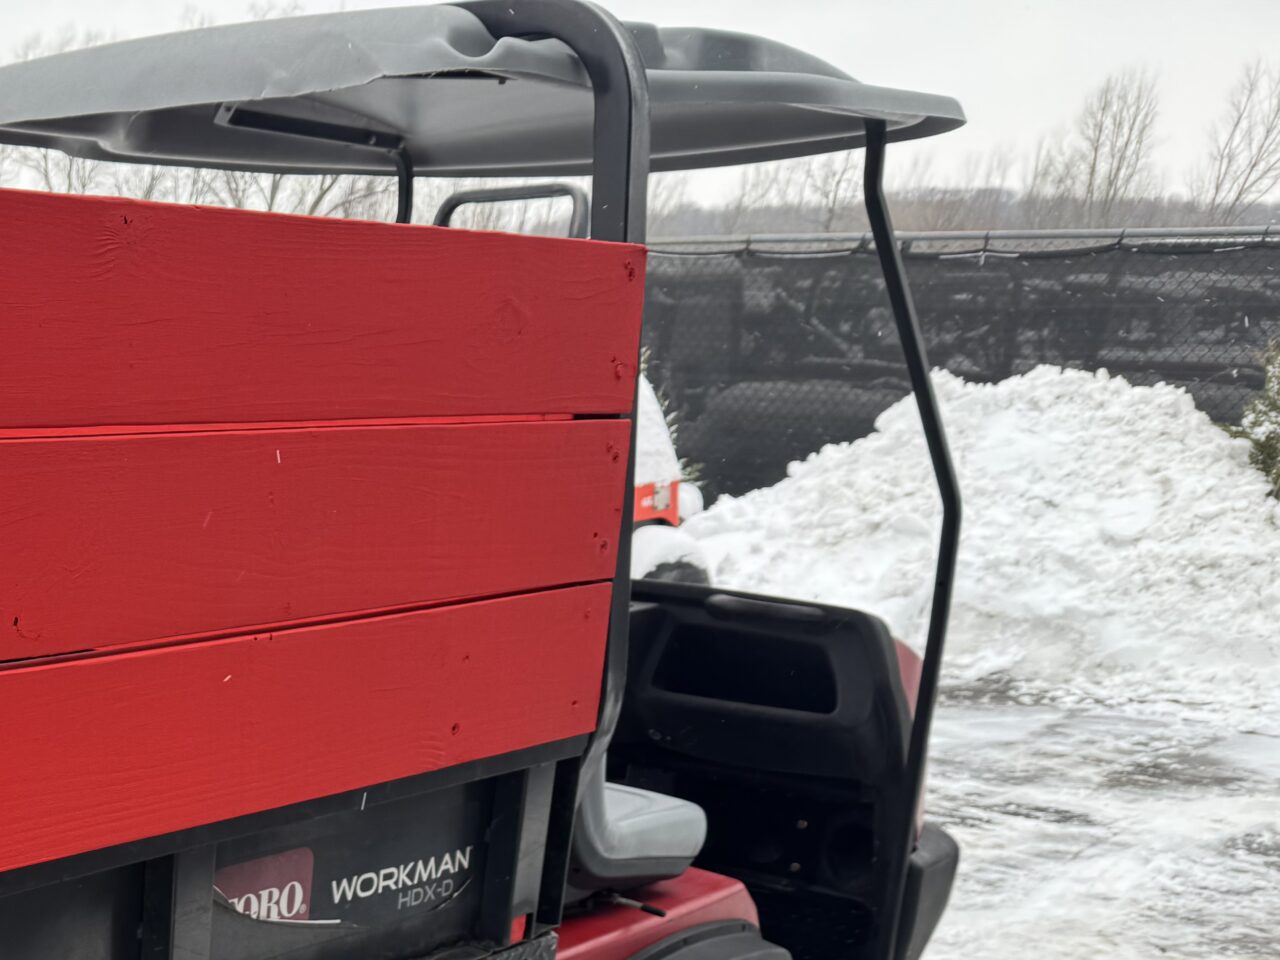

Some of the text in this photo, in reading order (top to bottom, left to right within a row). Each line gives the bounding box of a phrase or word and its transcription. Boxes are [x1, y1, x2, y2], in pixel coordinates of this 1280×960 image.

[331, 846, 473, 904] WORKMAN
[397, 878, 454, 910] HDX-D
[228, 881, 304, 920] ORO
